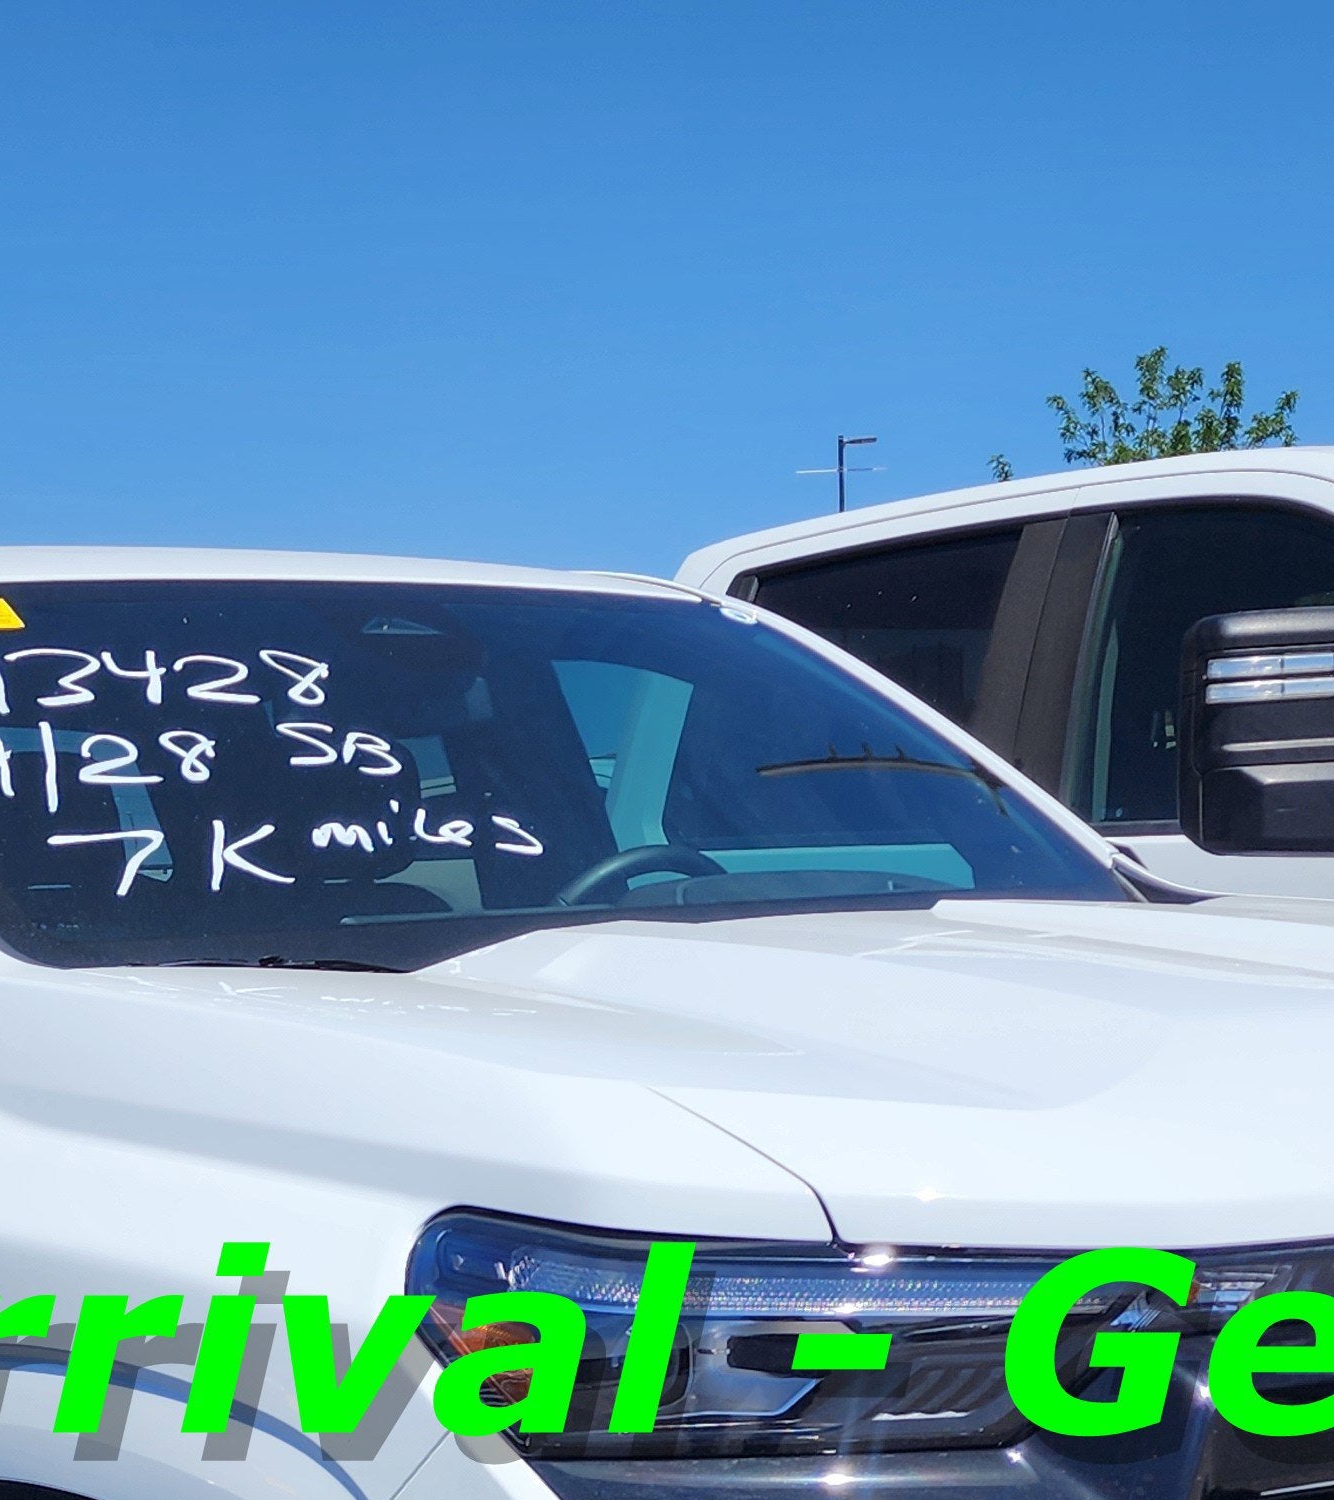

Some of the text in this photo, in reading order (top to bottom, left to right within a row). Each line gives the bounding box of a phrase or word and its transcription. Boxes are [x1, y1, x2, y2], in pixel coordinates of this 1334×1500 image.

[277, 722, 402, 775] SB
[47, 829, 165, 896] 7
[312, 800, 543, 855] miles
